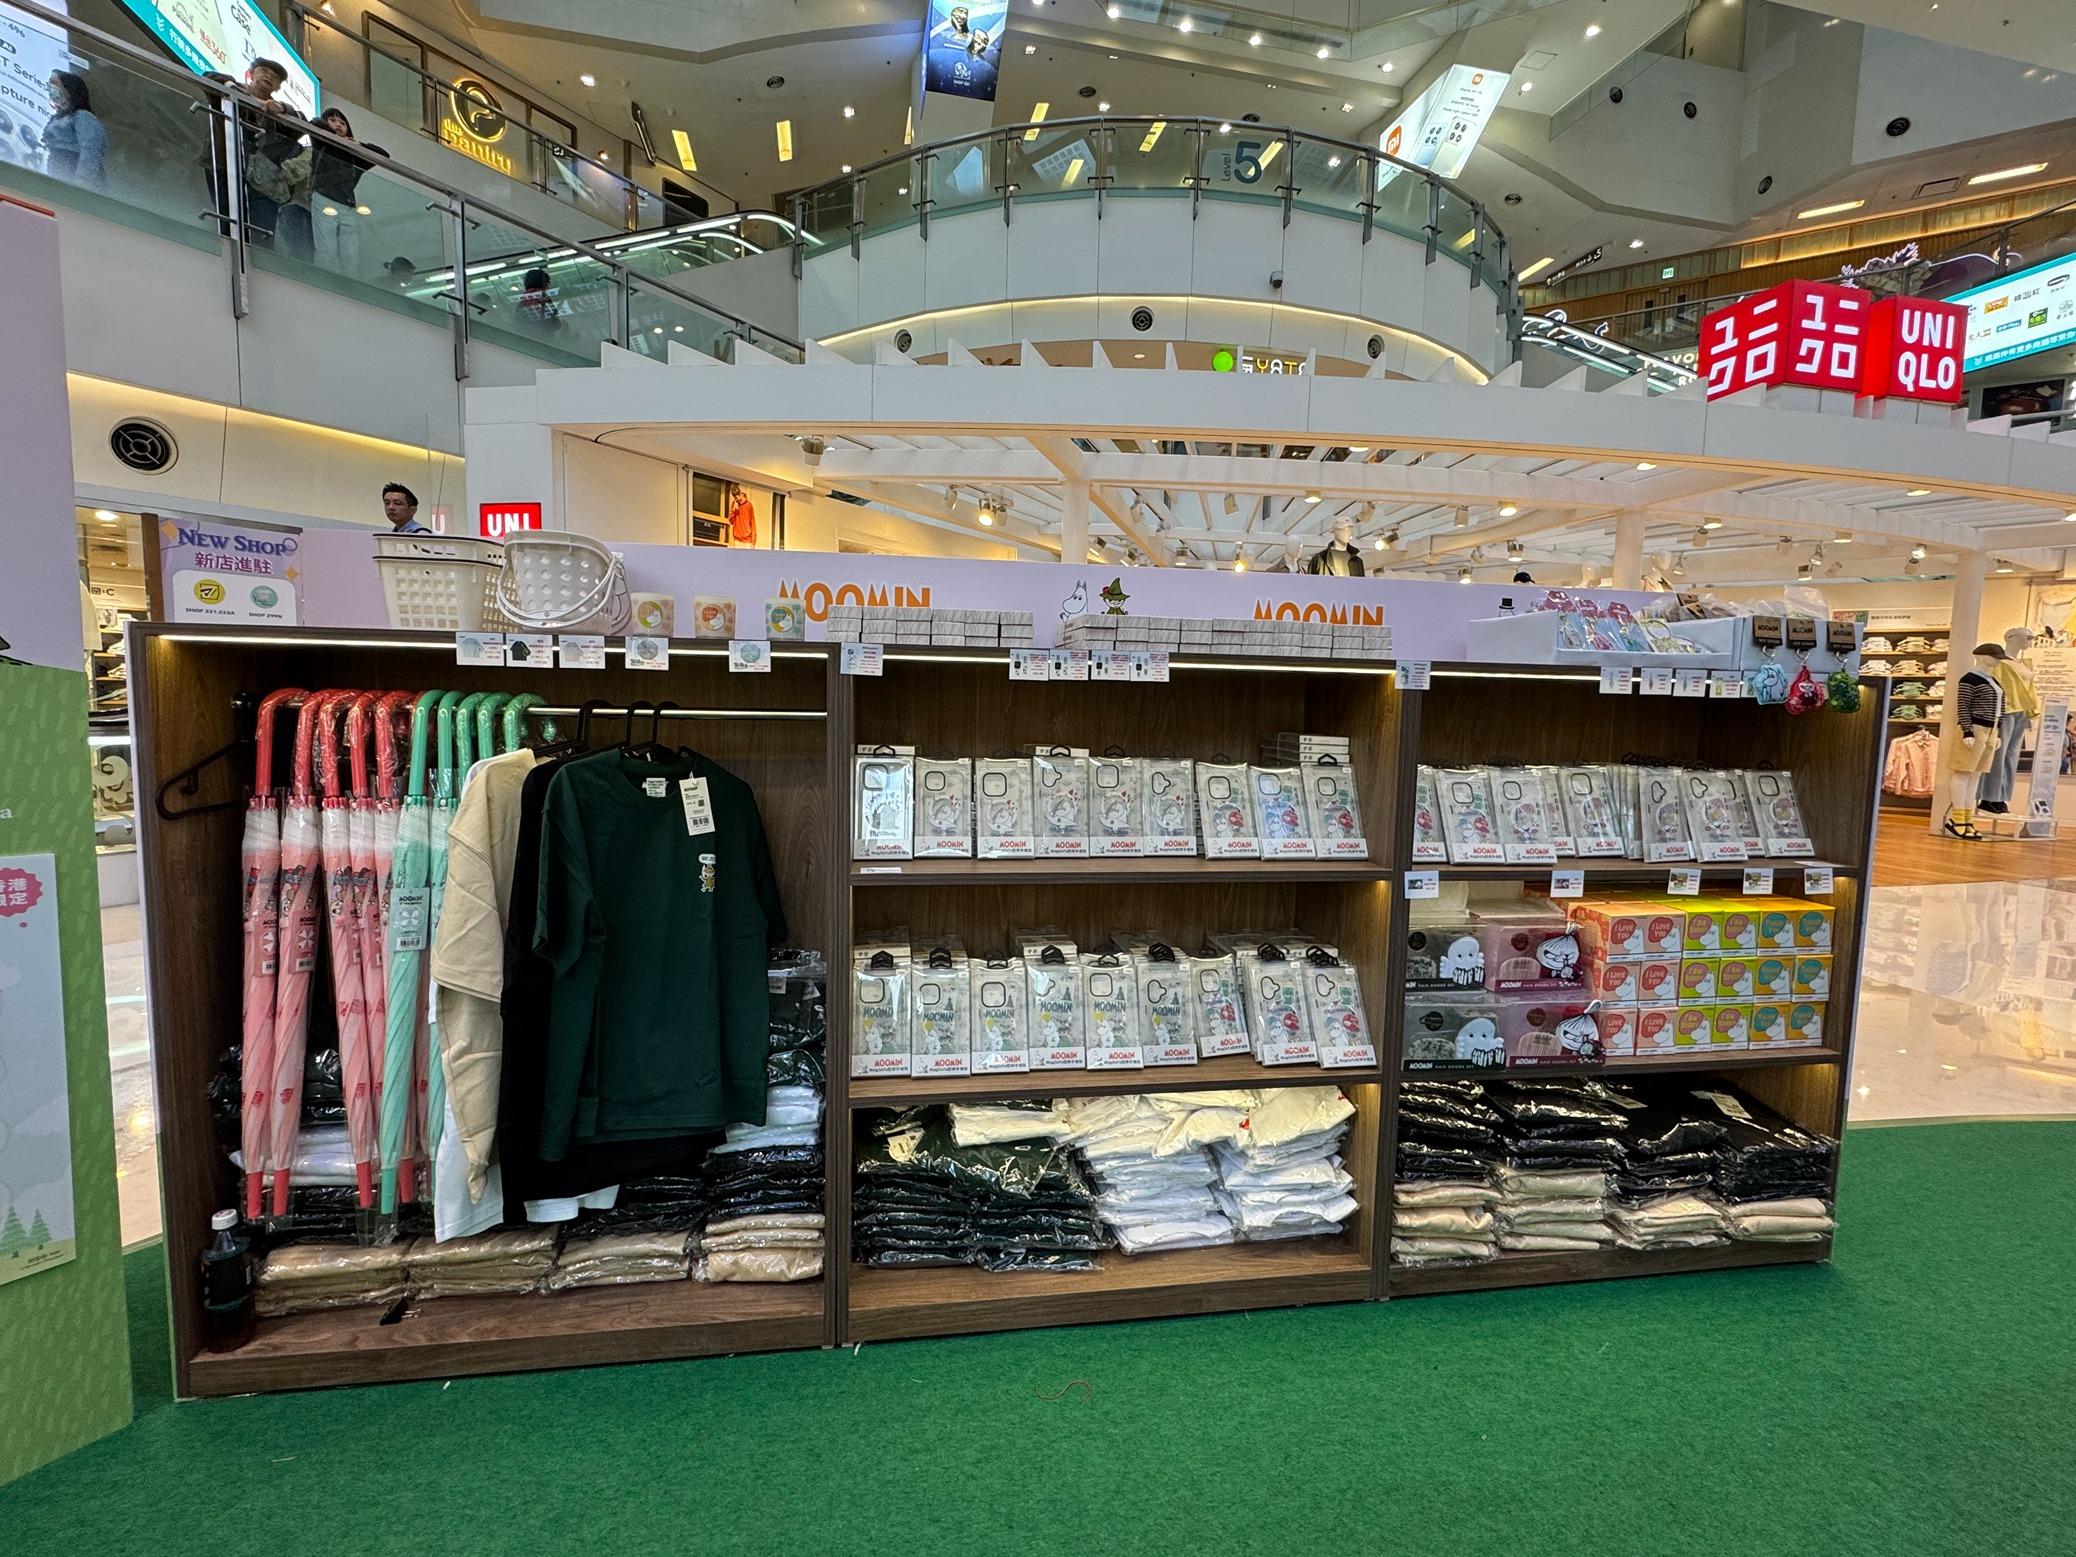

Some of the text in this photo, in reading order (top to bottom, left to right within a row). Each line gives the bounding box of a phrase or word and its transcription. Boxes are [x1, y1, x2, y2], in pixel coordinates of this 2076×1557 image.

[1221, 141, 1262, 184] Level 5
[1801, 294, 1859, 335] ユニ
[1710, 299, 1777, 355] ユニ
[1902, 309, 1955, 350] UNI
[1795, 339, 1857, 379] クロ
[1707, 340, 1777, 396] クロ
[1898, 352, 1956, 392] QLO
[487, 513, 529, 537] UNI
[178, 528, 285, 556] NEW SHOP
[195, 552, 273, 575] 新店進駐
[1254, 599, 1383, 625] MOOMIN
[936, 840, 964, 849] MOOMIN
[999, 840, 1026, 849] MOOMIN
[1055, 841, 1082, 849] MOOMIN
[1111, 841, 1136, 849] MOOMIN
[1164, 840, 1189, 848] MOOMIN
[1041, 1001, 1072, 1012] MOOMIN
[1094, 1001, 1126, 1012] MOOMIN
[1051, 1051, 1077, 1060] MOOMIN
[1109, 1052, 1135, 1060] MOOMIN
[1164, 1049, 1190, 1057] MOOMIN
[875, 1059, 902, 1067] MOOMIN
[935, 1059, 962, 1067] MOOMIN
